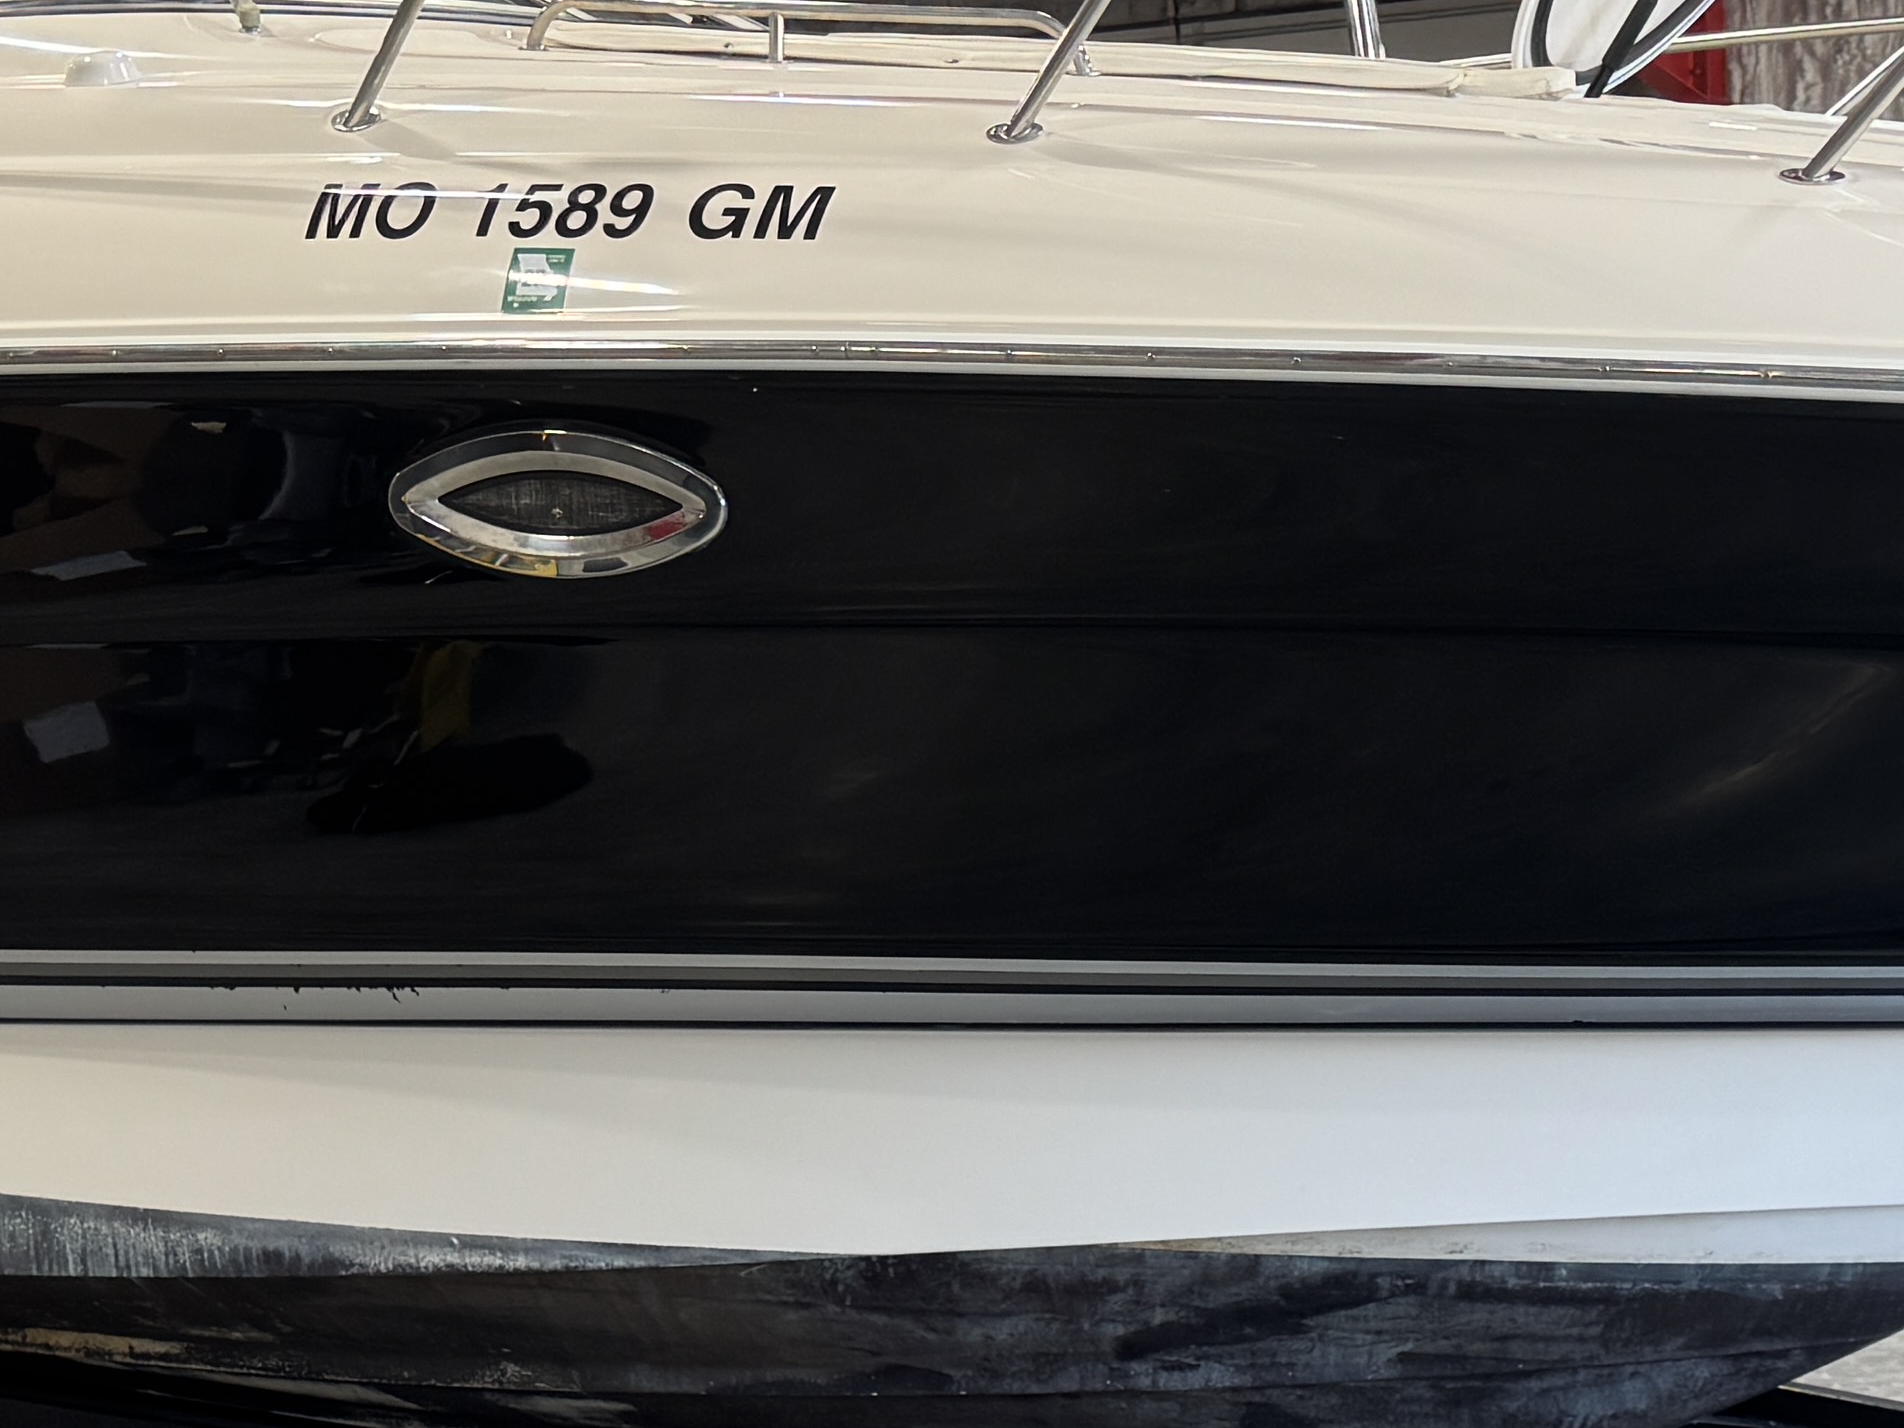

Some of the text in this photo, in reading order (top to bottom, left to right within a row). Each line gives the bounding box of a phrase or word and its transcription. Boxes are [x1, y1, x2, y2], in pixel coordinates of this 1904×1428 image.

[304, 182, 837, 241] MO 1589 GM
